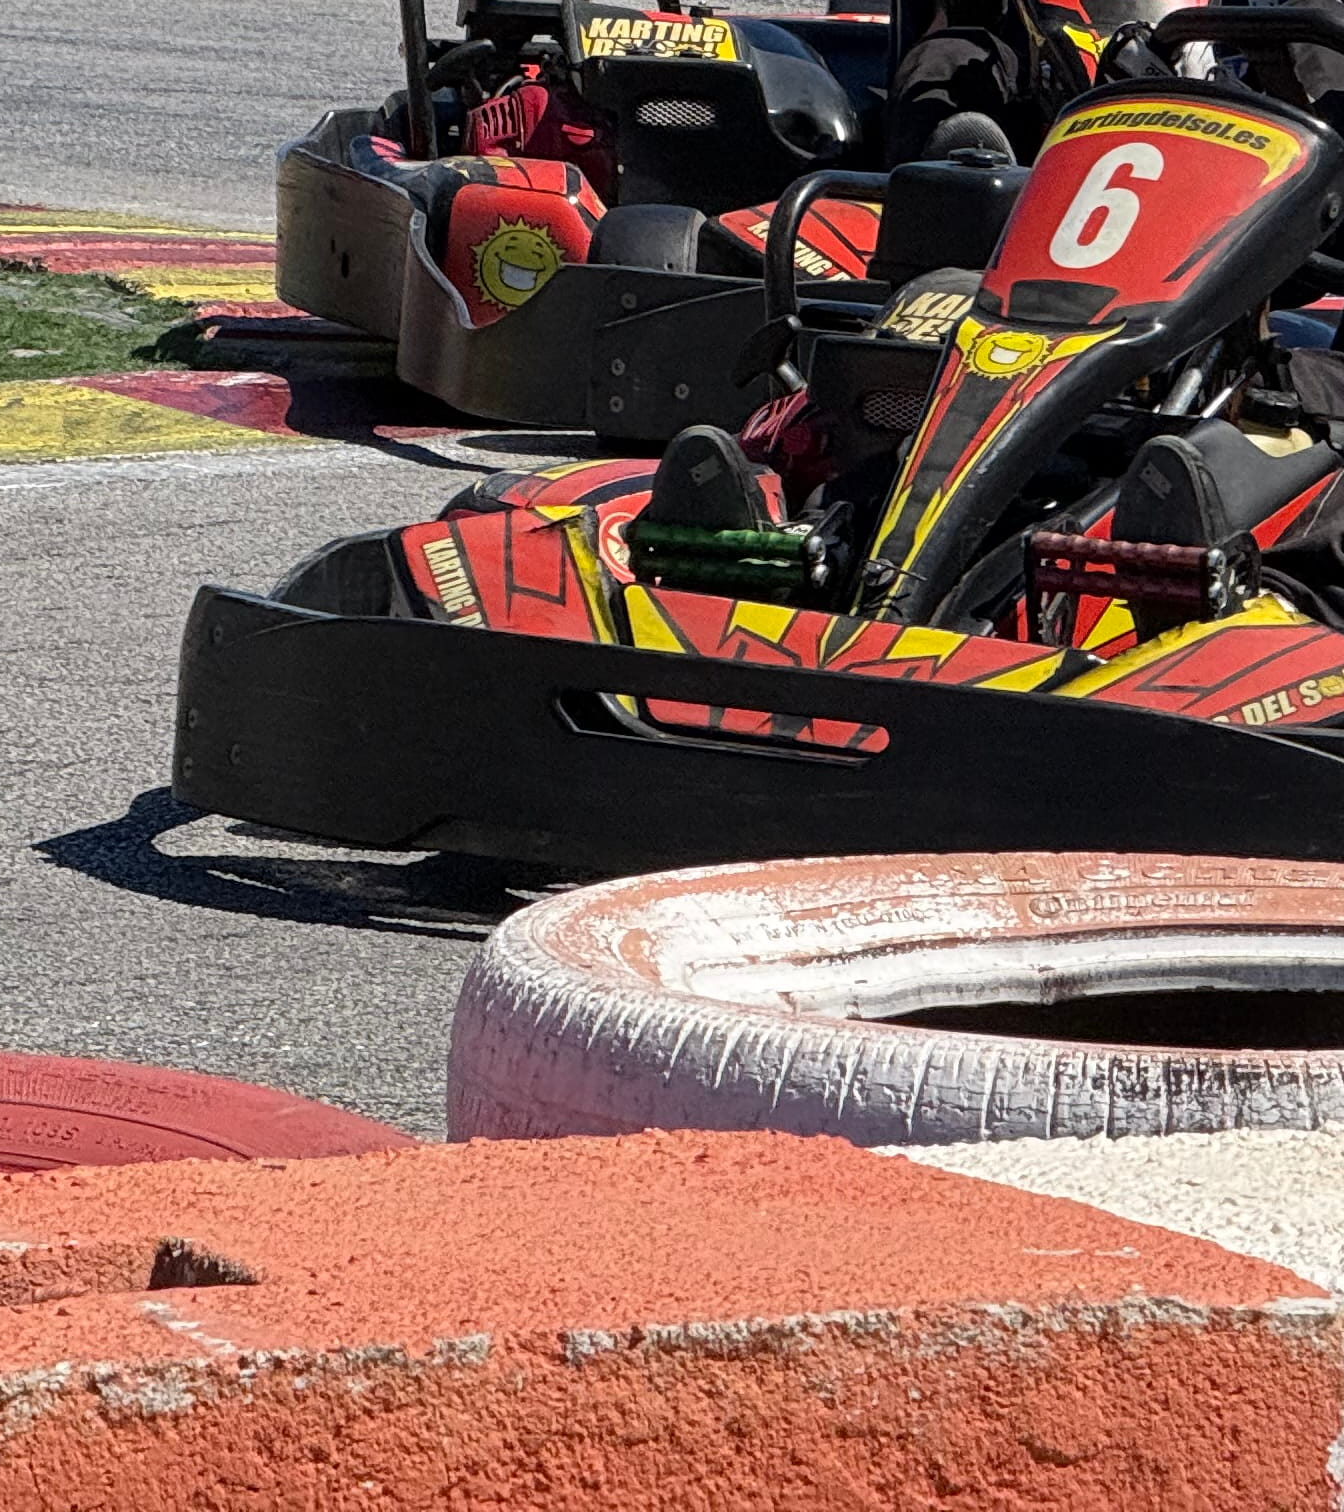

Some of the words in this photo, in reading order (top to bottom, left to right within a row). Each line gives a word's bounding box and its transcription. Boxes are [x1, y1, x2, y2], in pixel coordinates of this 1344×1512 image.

[588, 17, 726, 43] KARTING
[1063, 109, 1272, 151] kartingdelsol.es
[1048, 141, 1165, 269] 6
[422, 537, 476, 613] KARTING
[1241, 691, 1297, 726] DEL
